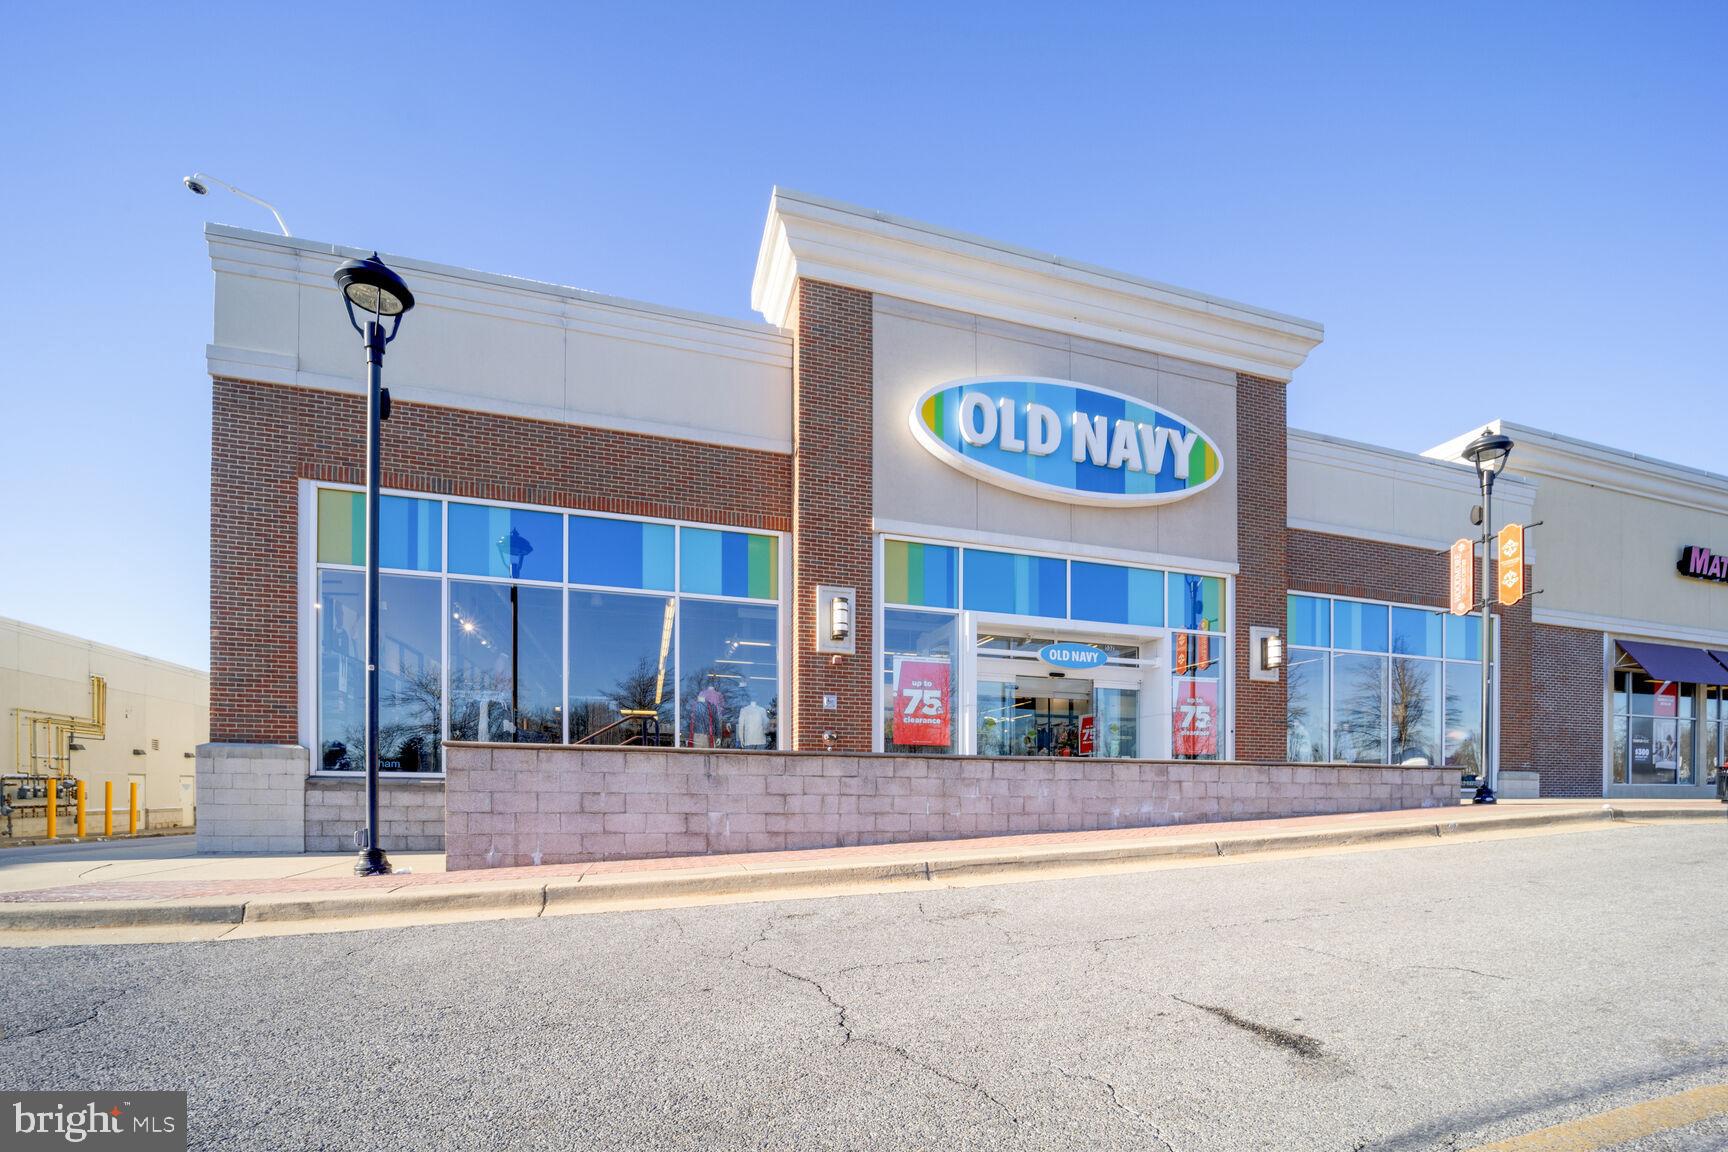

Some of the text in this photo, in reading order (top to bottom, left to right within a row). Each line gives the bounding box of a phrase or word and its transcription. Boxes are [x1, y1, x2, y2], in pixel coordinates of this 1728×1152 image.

[959, 392, 1198, 479] OLD NAVY
[1050, 650, 1099, 663] OLD NAVY
[903, 688, 942, 716] 75
[904, 716, 941, 724] clearance
[1181, 706, 1211, 729] 75
